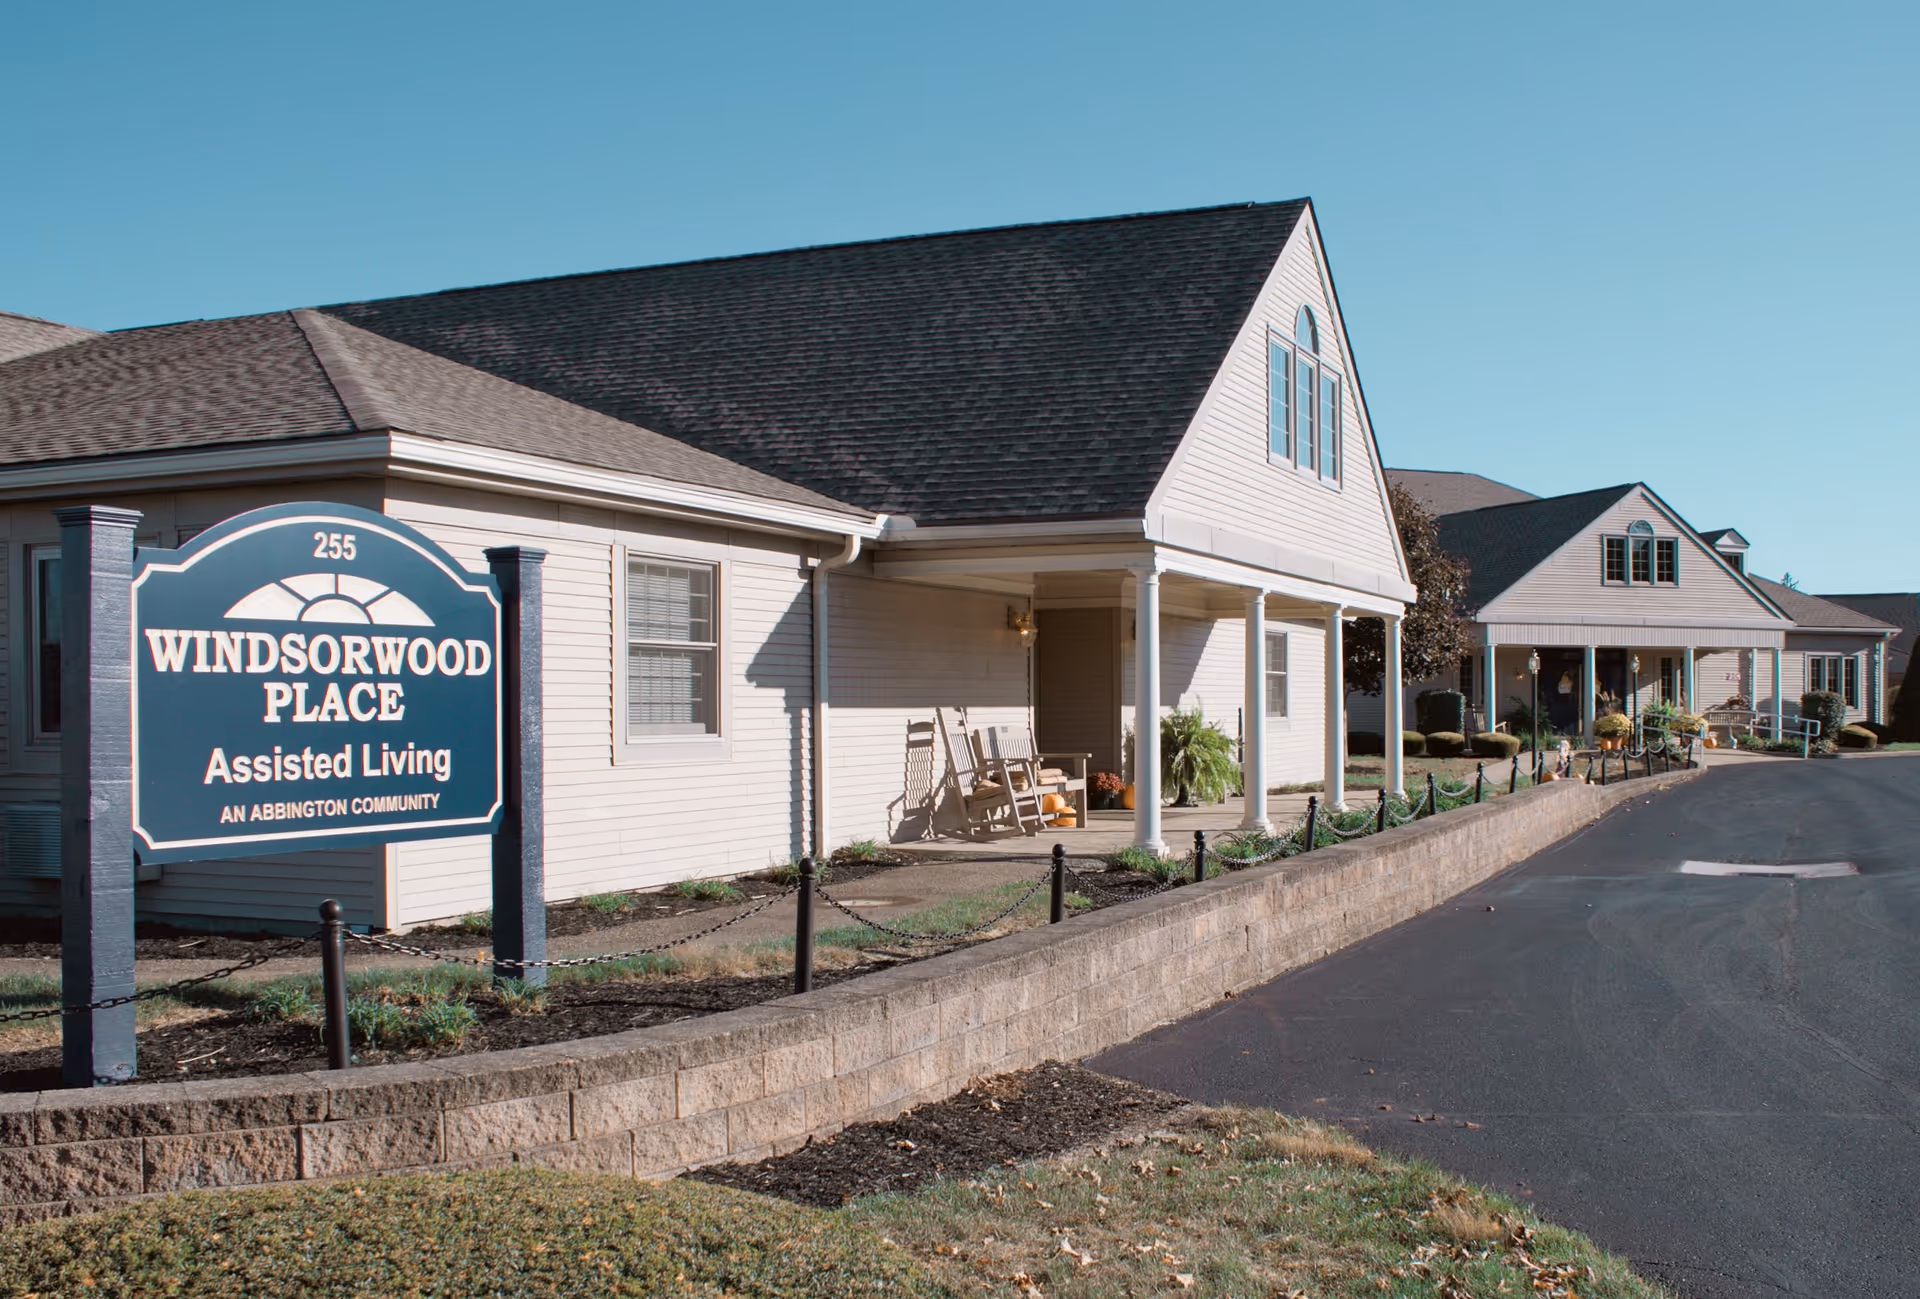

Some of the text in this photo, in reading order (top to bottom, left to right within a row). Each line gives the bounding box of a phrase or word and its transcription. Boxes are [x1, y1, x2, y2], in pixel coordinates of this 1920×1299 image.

[313, 531, 357, 561] 255
[145, 628, 492, 677] WINDSORWOOD
[263, 681, 406, 723] PLACE
[203, 742, 451, 784] Assisted Living
[219, 792, 440, 824] AN ABBINGTON COMMUNITY
